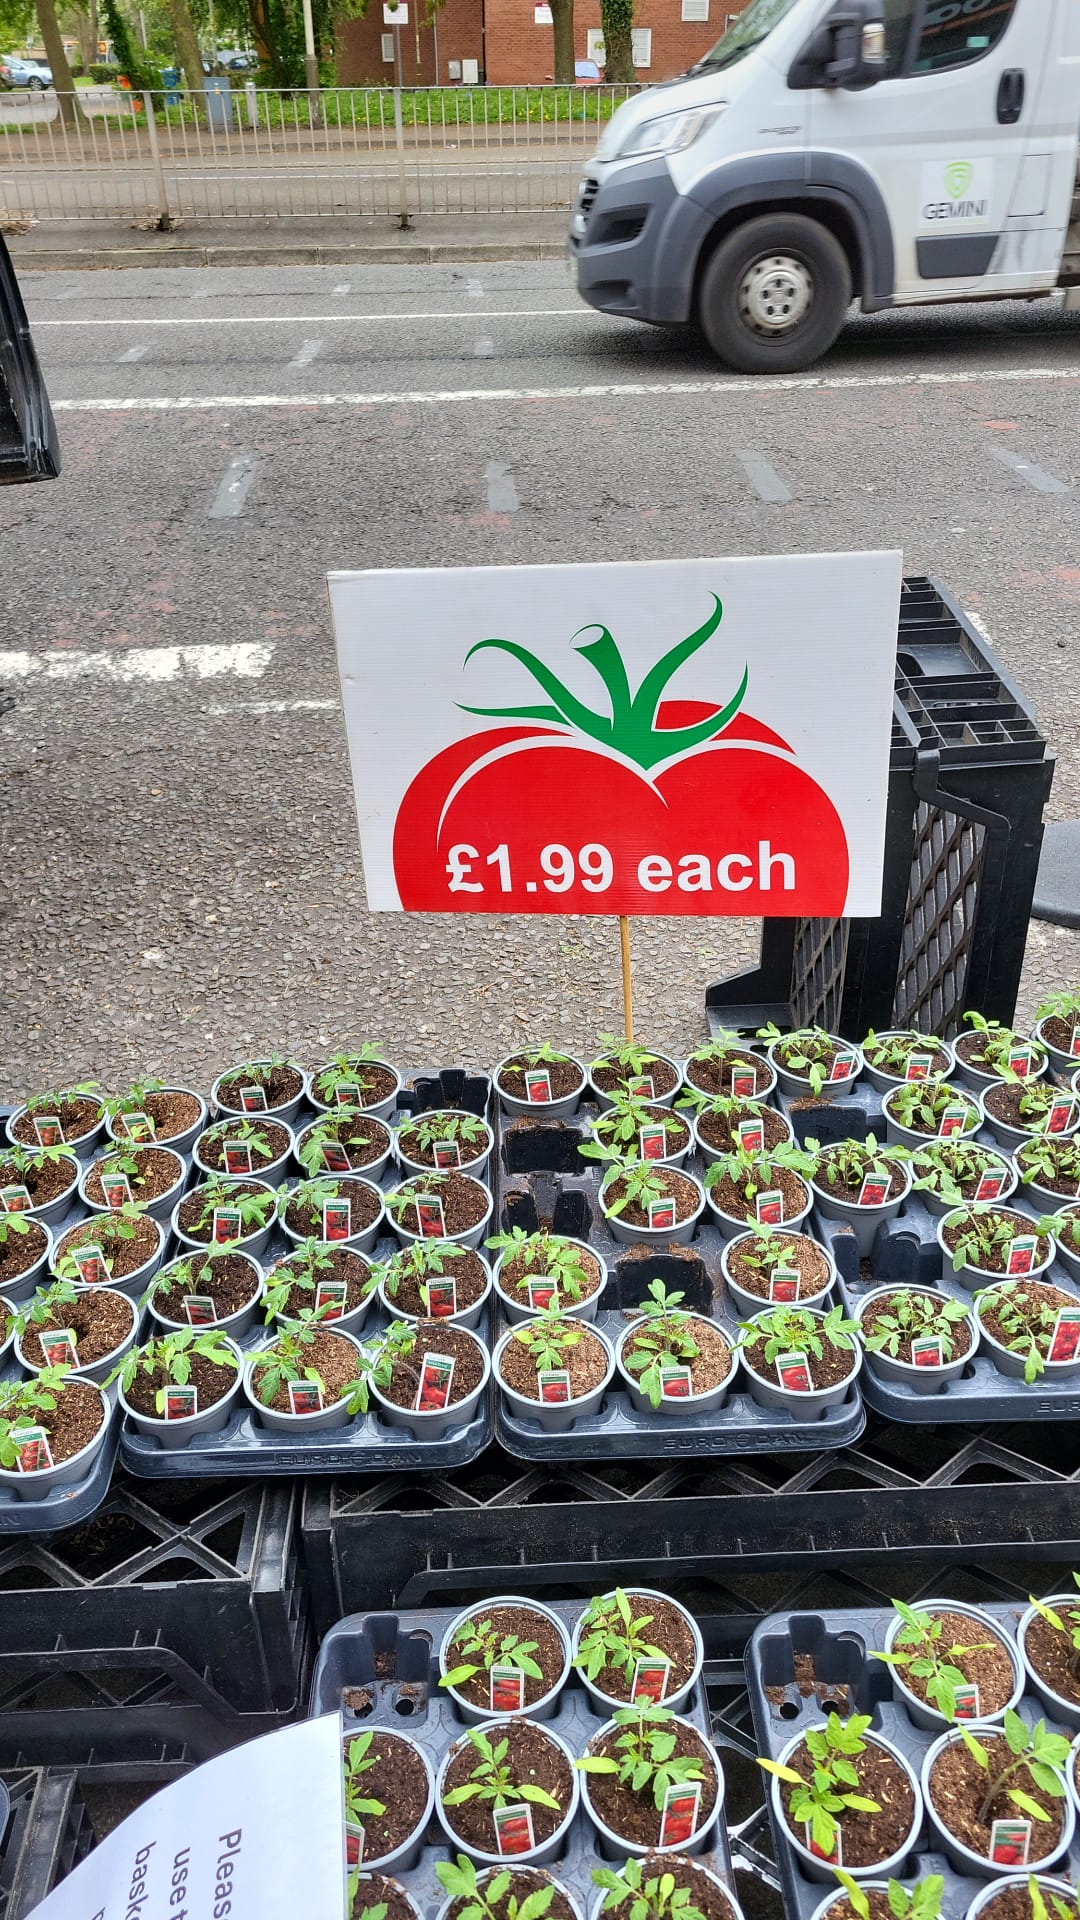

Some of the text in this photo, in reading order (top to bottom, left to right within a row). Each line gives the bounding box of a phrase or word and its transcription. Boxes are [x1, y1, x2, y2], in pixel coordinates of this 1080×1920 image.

[922, 200, 989, 219] GEMINI
[445, 840, 796, 893] £1.99 each
[125, 1840, 157, 1920] bask
[169, 1846, 191, 1906] use
[213, 1828, 242, 1920] Pleas
